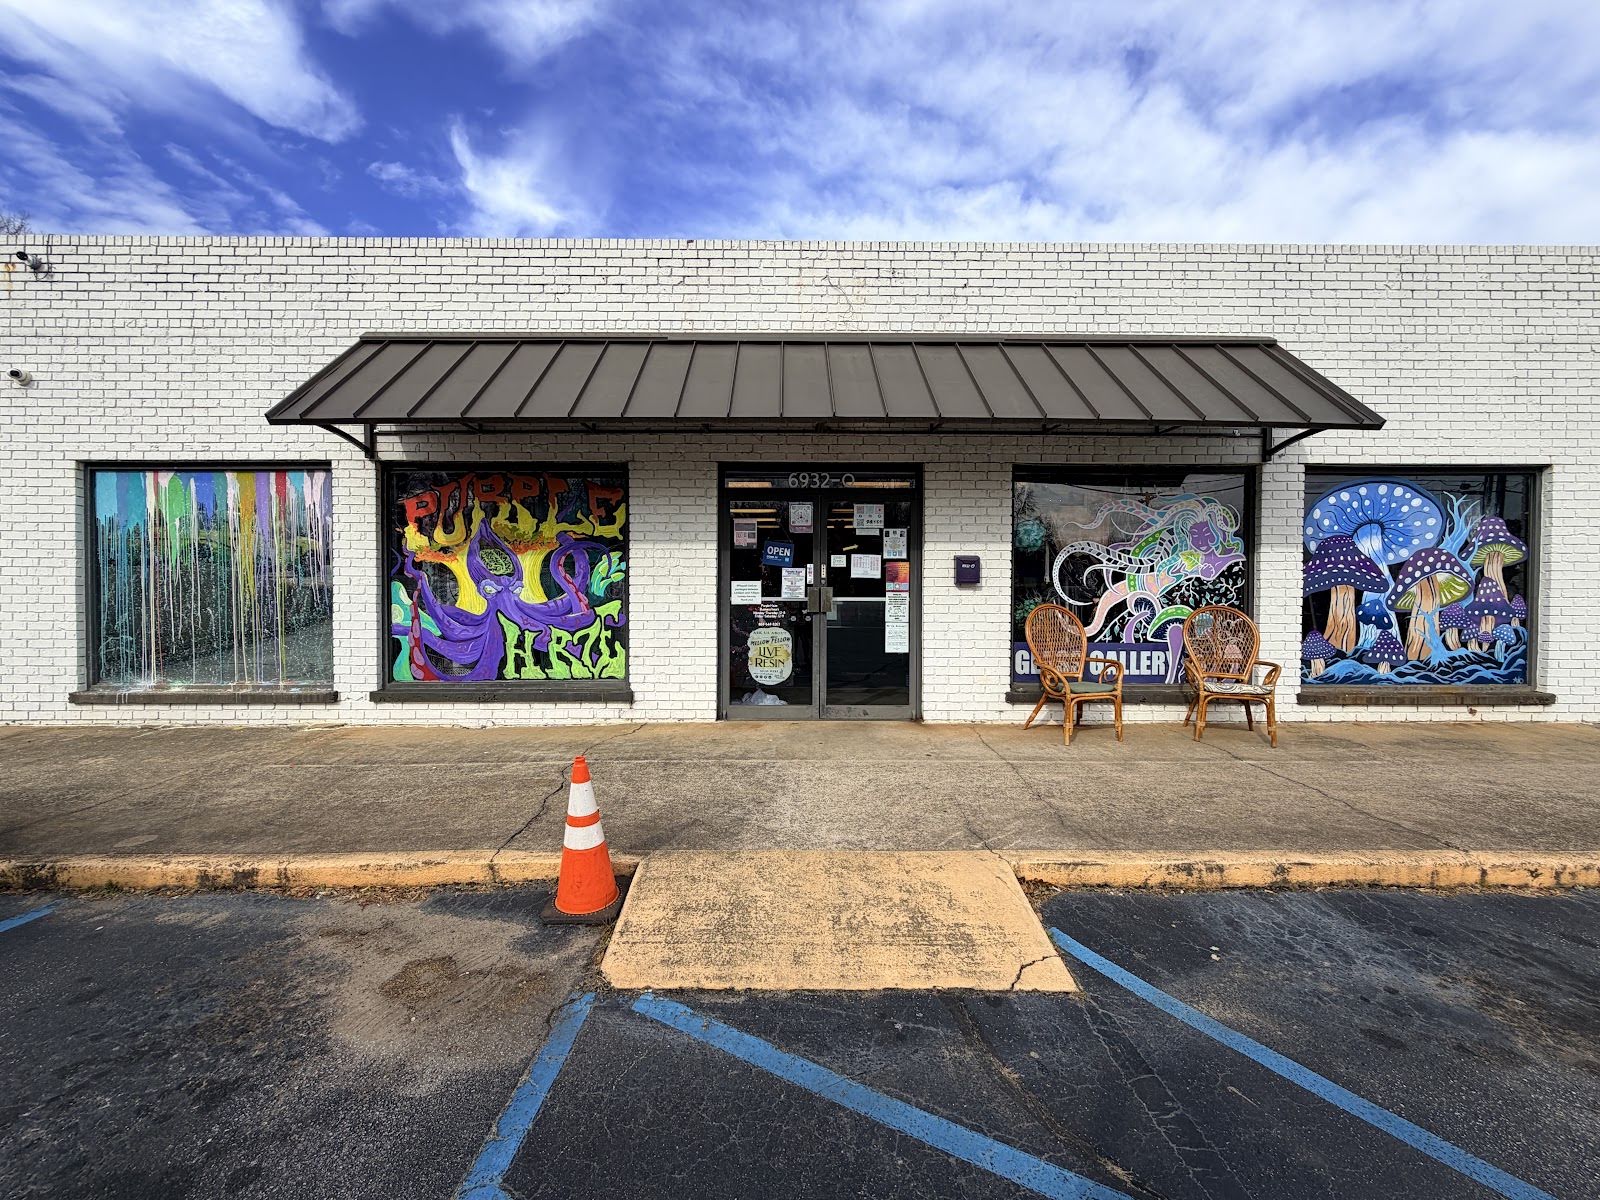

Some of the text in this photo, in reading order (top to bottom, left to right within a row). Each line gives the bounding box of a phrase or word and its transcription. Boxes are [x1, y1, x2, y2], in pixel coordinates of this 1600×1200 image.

[403, 472, 627, 552] PURPLE
[766, 546, 791, 556] OPEN
[498, 600, 627, 680] HAZE
[758, 646, 782, 658] LIVE
[755, 657, 785, 668] RESIN
[1089, 650, 1171, 675] GALLER
